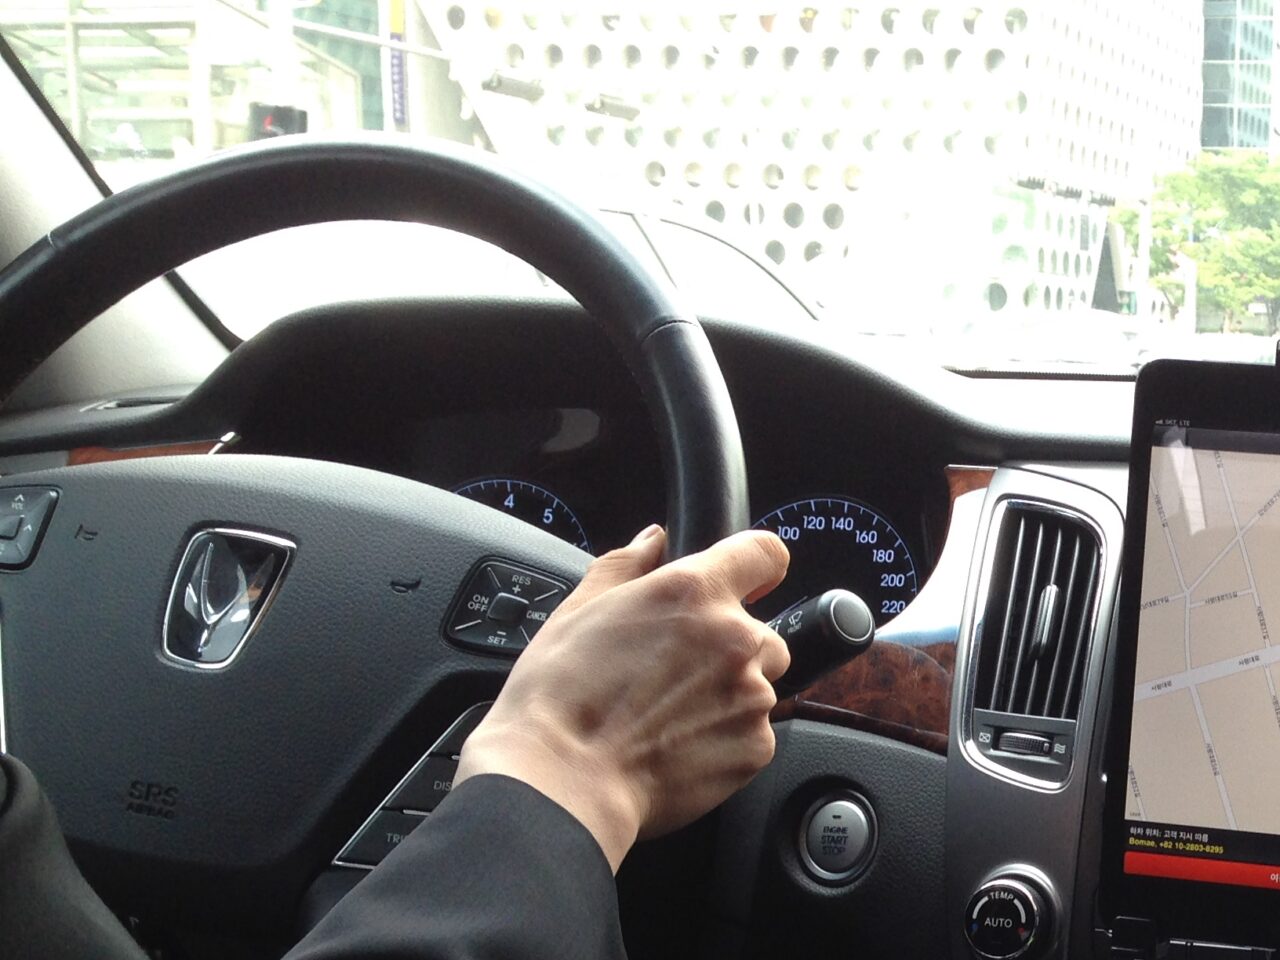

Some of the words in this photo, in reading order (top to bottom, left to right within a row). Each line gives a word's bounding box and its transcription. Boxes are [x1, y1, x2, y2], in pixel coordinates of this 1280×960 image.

[504, 493, 515, 508] 4
[543, 508, 553, 524] 5
[803, 515, 825, 530] 120
[831, 516, 853, 531] 140
[777, 525, 800, 540] 100
[855, 530, 877, 544] 160
[872, 549, 894, 563] 180
[511, 574, 532, 585] RES
[880, 573, 905, 587] 200
[473, 594, 489, 604] ON
[467, 601, 488, 612] OFF
[881, 600, 906, 614] 220
[526, 609, 548, 621] CANCEL
[487, 635, 507, 645] SET
[433, 780, 453, 792] DIS
[129, 780, 179, 807] SRS
[823, 826, 848, 835] ENGINE
[1179, 831, 1193, 841] 지시
[386, 832, 404, 844] TRI
[821, 835, 848, 846] START
[822, 846, 846, 856] STOP
[1159, 841, 1172, 850] +82
[990, 890, 1014, 901] TEMP
[984, 916, 1013, 928] AUTO
